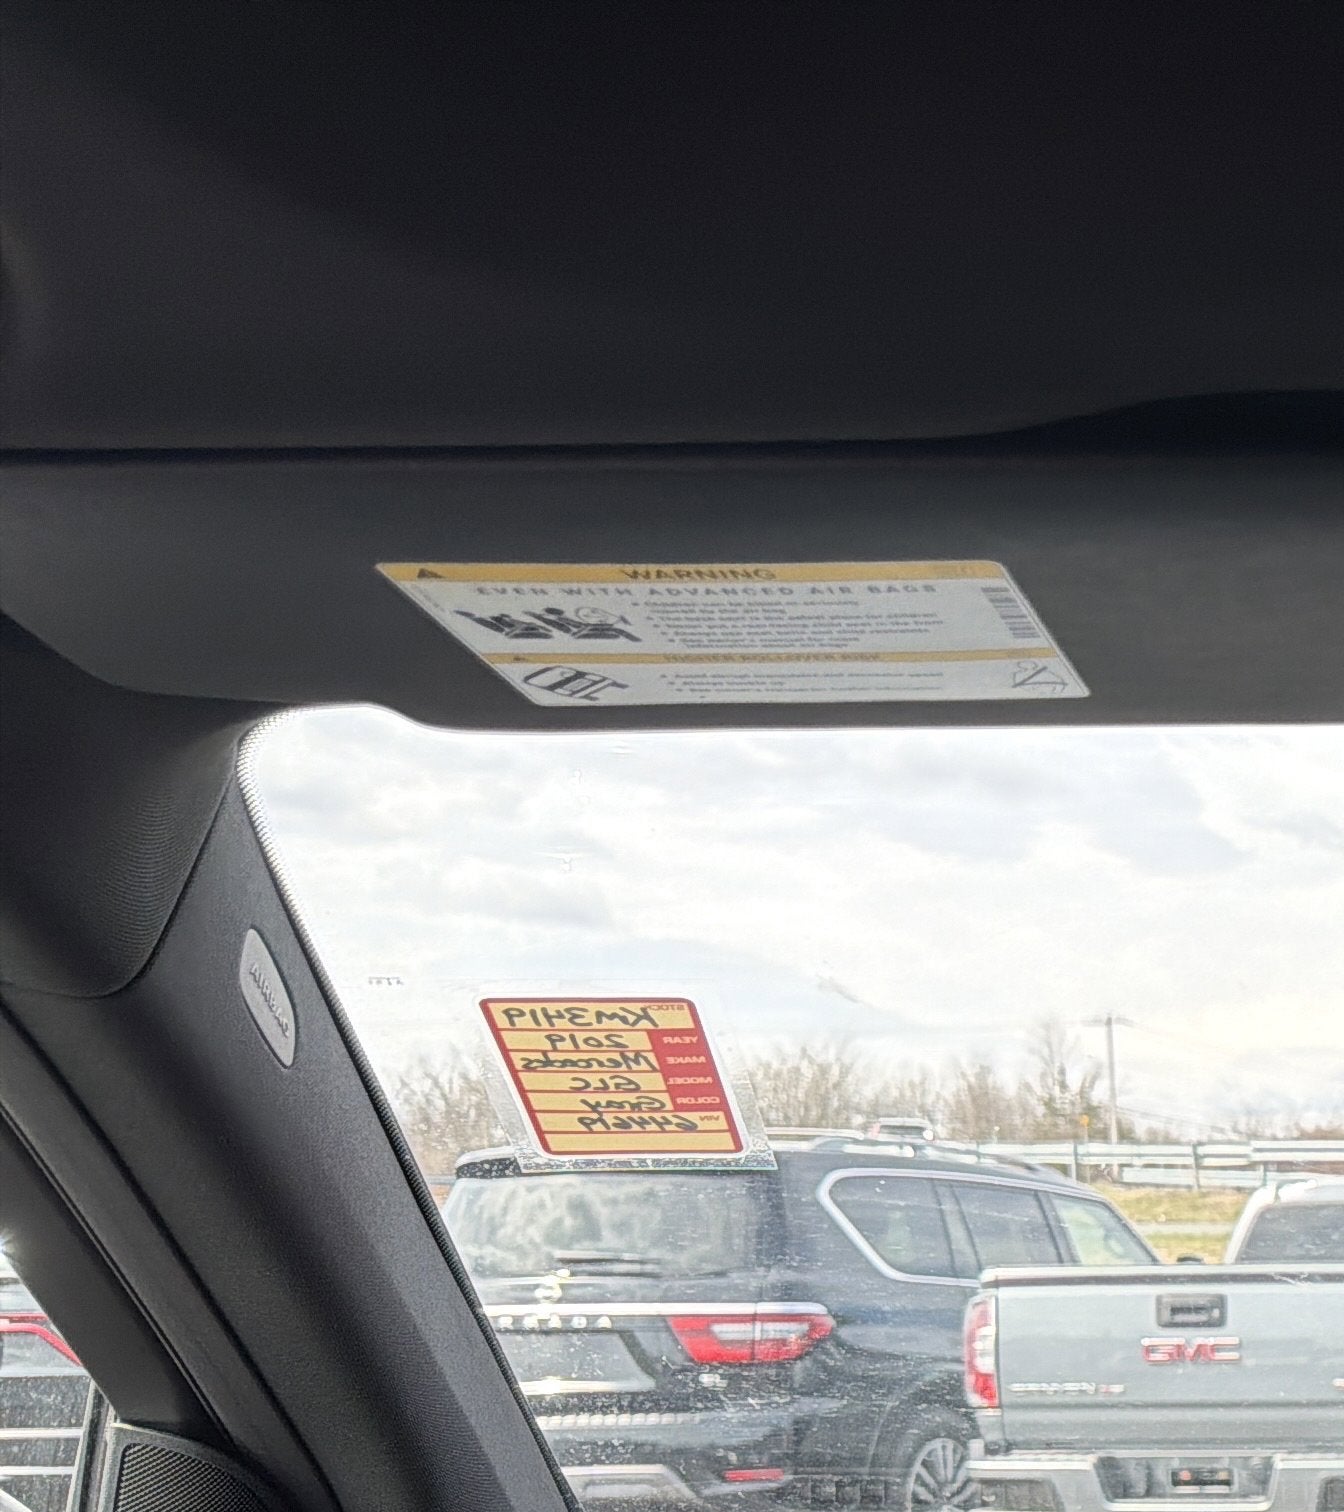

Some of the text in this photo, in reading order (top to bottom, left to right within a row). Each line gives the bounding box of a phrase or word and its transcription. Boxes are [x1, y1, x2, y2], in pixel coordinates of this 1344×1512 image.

[620, 568, 776, 581] WARNING
[560, 587, 633, 597] WITH
[649, 587, 794, 597] ADVANCED
[810, 585, 854, 595] AIR
[867, 584, 937, 594] BAGS
[1140, 1335, 1241, 1365] GMC
